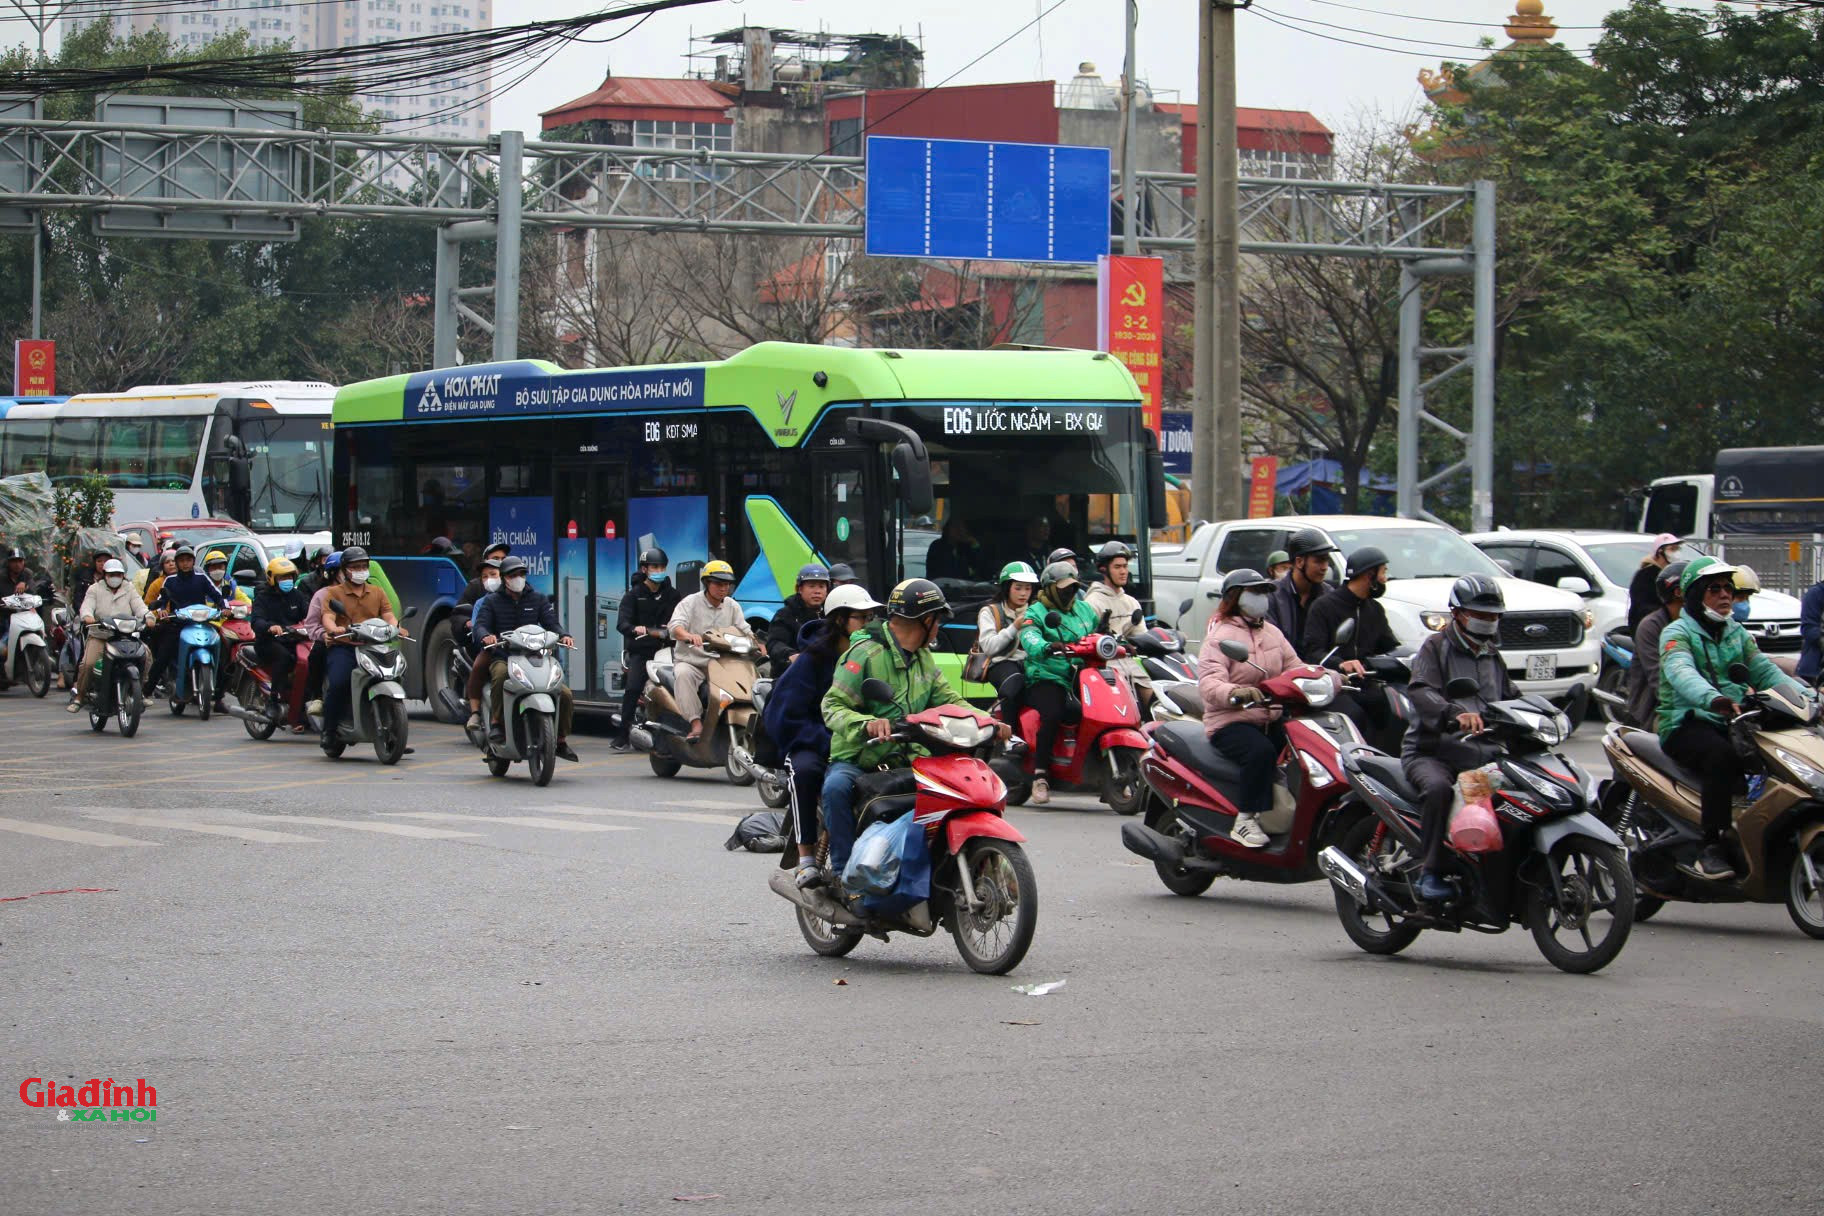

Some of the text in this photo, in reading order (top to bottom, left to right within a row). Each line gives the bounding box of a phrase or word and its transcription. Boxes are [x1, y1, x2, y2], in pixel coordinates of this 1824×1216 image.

[1124, 315, 1148, 329] 3-2
[515, 377, 693, 409] BỘ SƯU TẬP GIA DỤNG HÒA PHÁT MỚI
[444, 400, 457, 413] ĐIỆN
[469, 400, 479, 410] GIA
[479, 399, 495, 412] DỤNG
[943, 407, 972, 434] E06
[1010, 406, 1051, 431] NGẦM
[1065, 412, 1083, 431] BX
[645, 421, 660, 442] E06
[492, 526, 537, 546] BỀN CHUẨN
